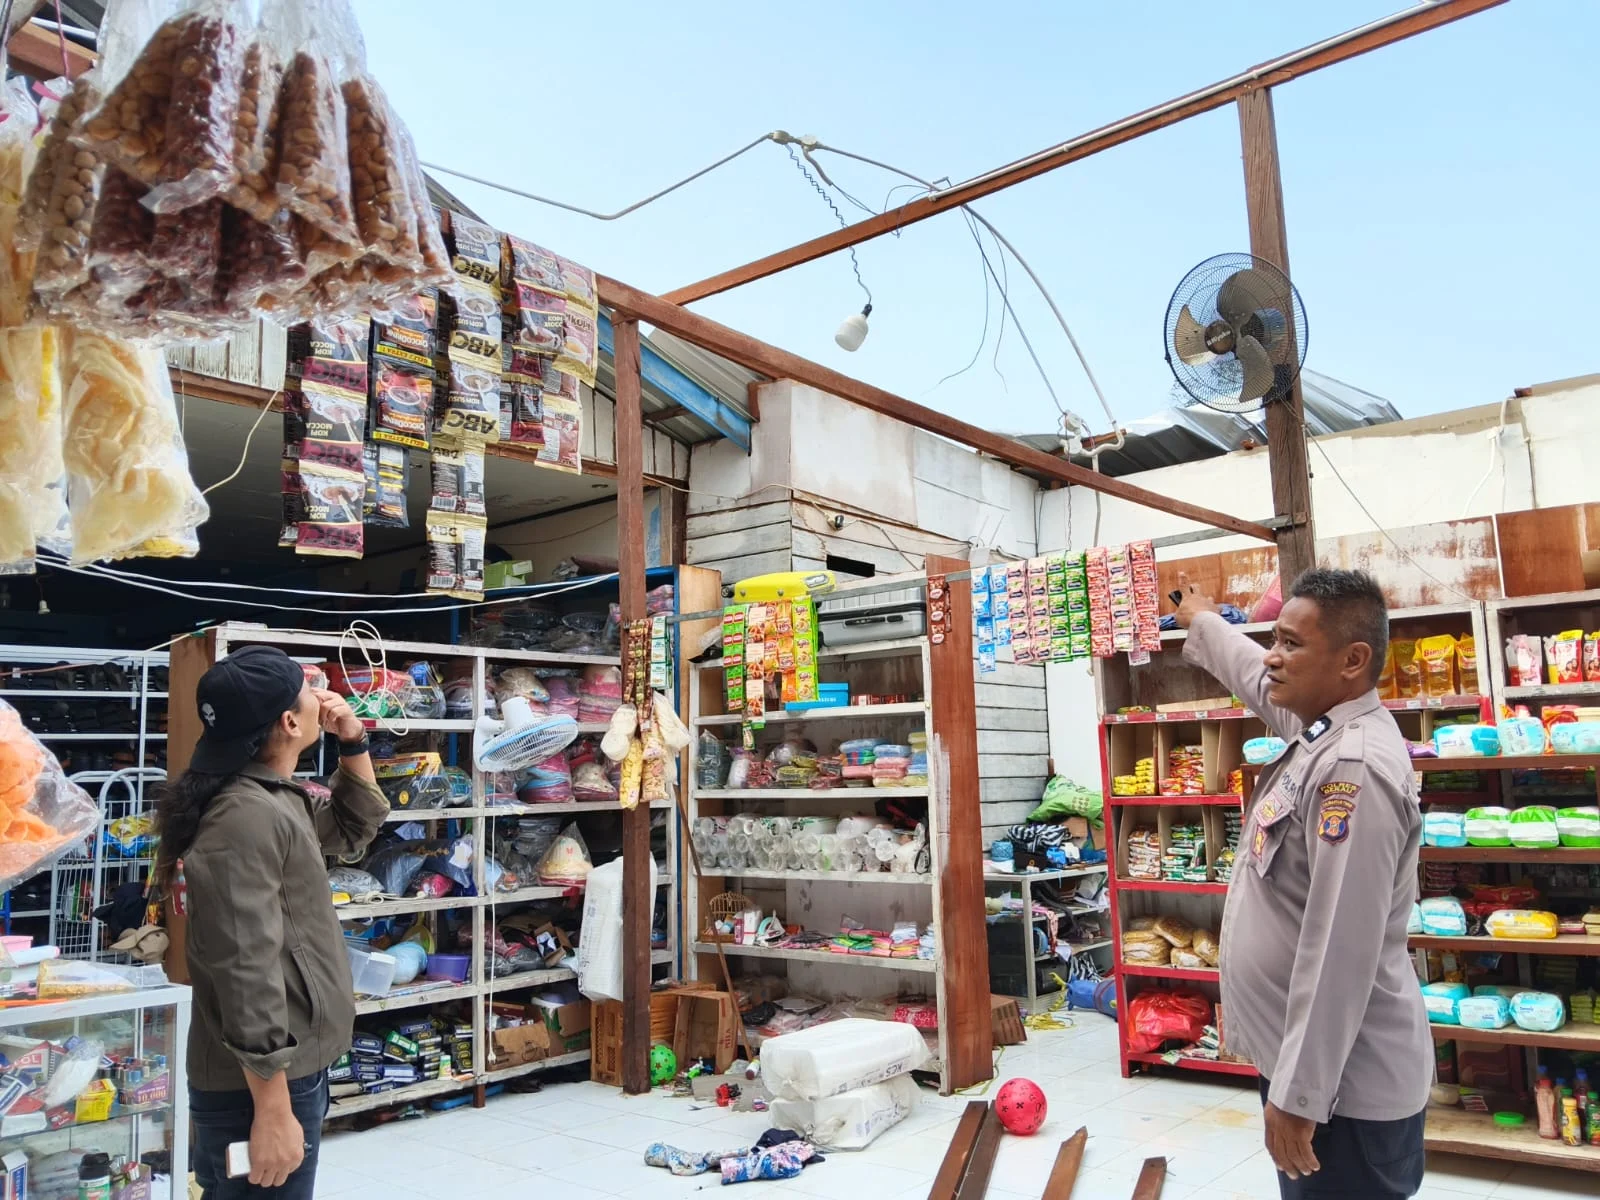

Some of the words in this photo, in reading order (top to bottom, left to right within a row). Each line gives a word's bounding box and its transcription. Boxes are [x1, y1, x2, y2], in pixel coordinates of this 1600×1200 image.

[454, 257, 498, 285] ABC
[310, 341, 336, 349] MOCCA
[451, 332, 498, 357] ABC
[311, 361, 366, 387] ABC
[305, 422, 333, 430] MOCCA
[446, 411, 497, 434] ABC
[431, 446, 459, 460] ABC
[428, 524, 457, 537] ABC
